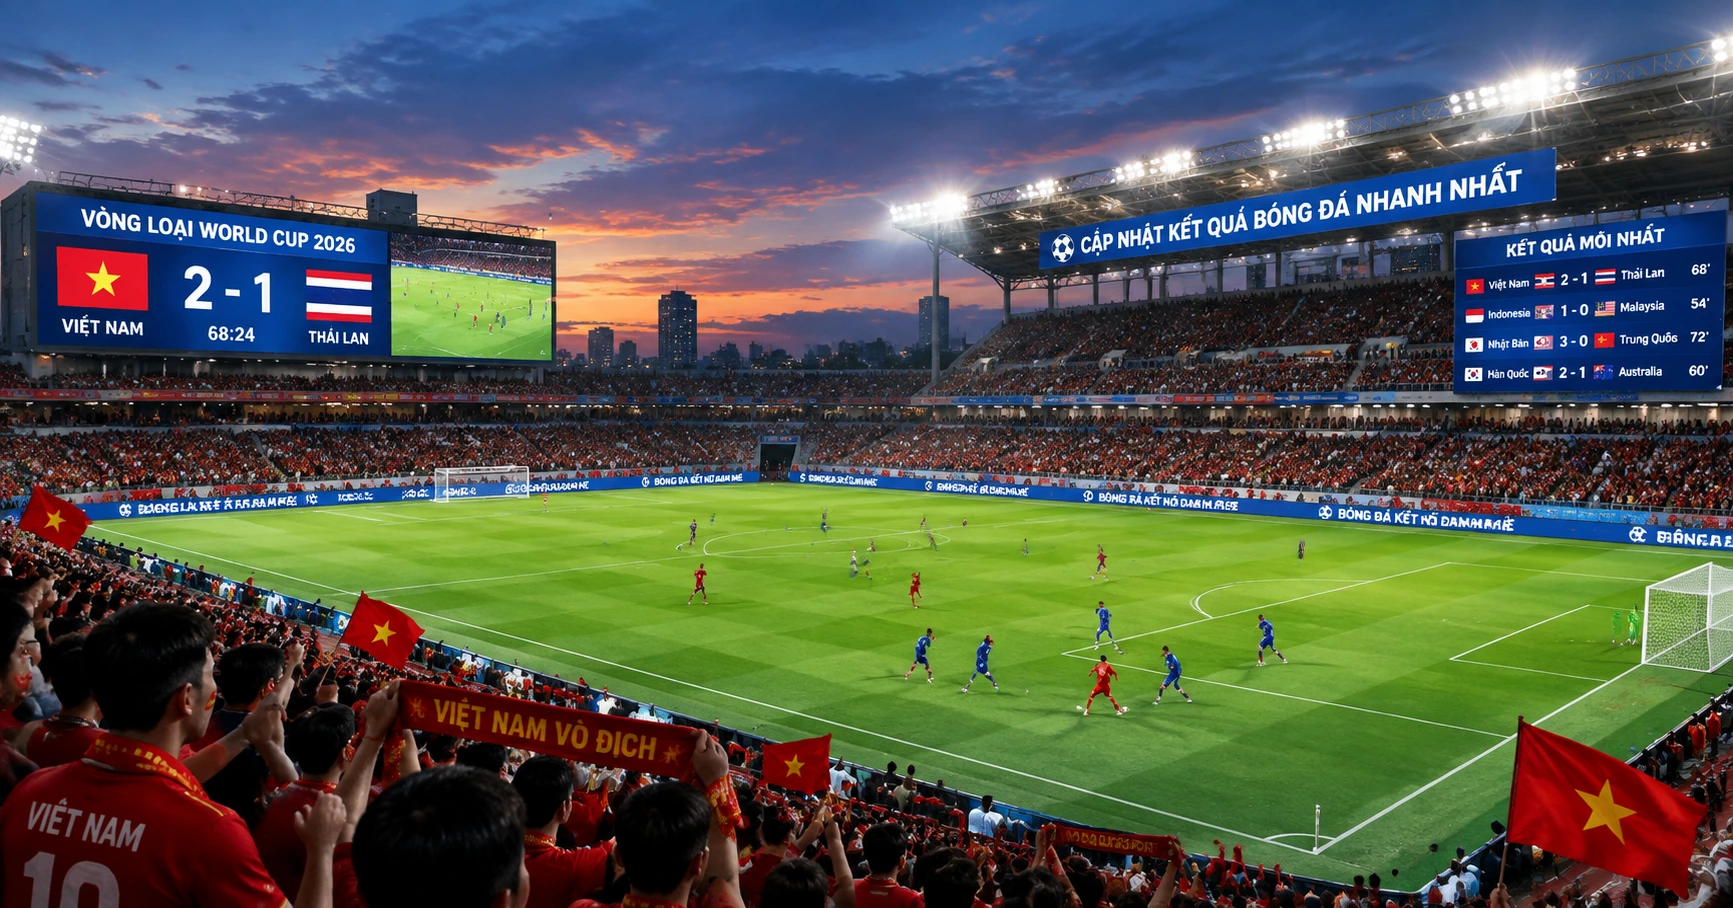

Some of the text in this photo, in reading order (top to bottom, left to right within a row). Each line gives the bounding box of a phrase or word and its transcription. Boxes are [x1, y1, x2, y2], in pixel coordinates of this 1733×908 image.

[1168, 214, 1202, 242] KẾT
[1254, 202, 1312, 229] BÓNG
[1318, 190, 1350, 220] ĐÁ
[1356, 182, 1442, 215] NHANH
[1450, 162, 1522, 200] NHẤT
[80, 206, 356, 254] VÒNG LOẠI WORLD CUP 2026
[1560, 274, 1568, 286] 2
[1580, 272, 1588, 284] 1
[1645, 268, 1665, 278] Lan
[184, 265, 212, 310] 2
[254, 272, 271, 314] 1
[1508, 279, 1530, 288] Nam
[1560, 305, 1568, 316] 1
[1579, 304, 1589, 316] 0
[1620, 300, 1665, 313] Malaysia
[106, 320, 144, 336] NAM
[208, 326, 256, 342] 68:24
[343, 332, 369, 346] LAN
[1560, 335, 1568, 347] 3
[1579, 334, 1588, 346] 0
[1620, 334, 1649, 346] Trung
[1559, 367, 1568, 379] 2
[1579, 366, 1586, 378] 1
[1618, 366, 1663, 378] Australia
[434, 697, 486, 732] VIỆT
[492, 710, 547, 742] NAM
[596, 729, 657, 760] ĐỊCH
[82, 812, 146, 852] NAM
[23, 851, 120, 908] 10
